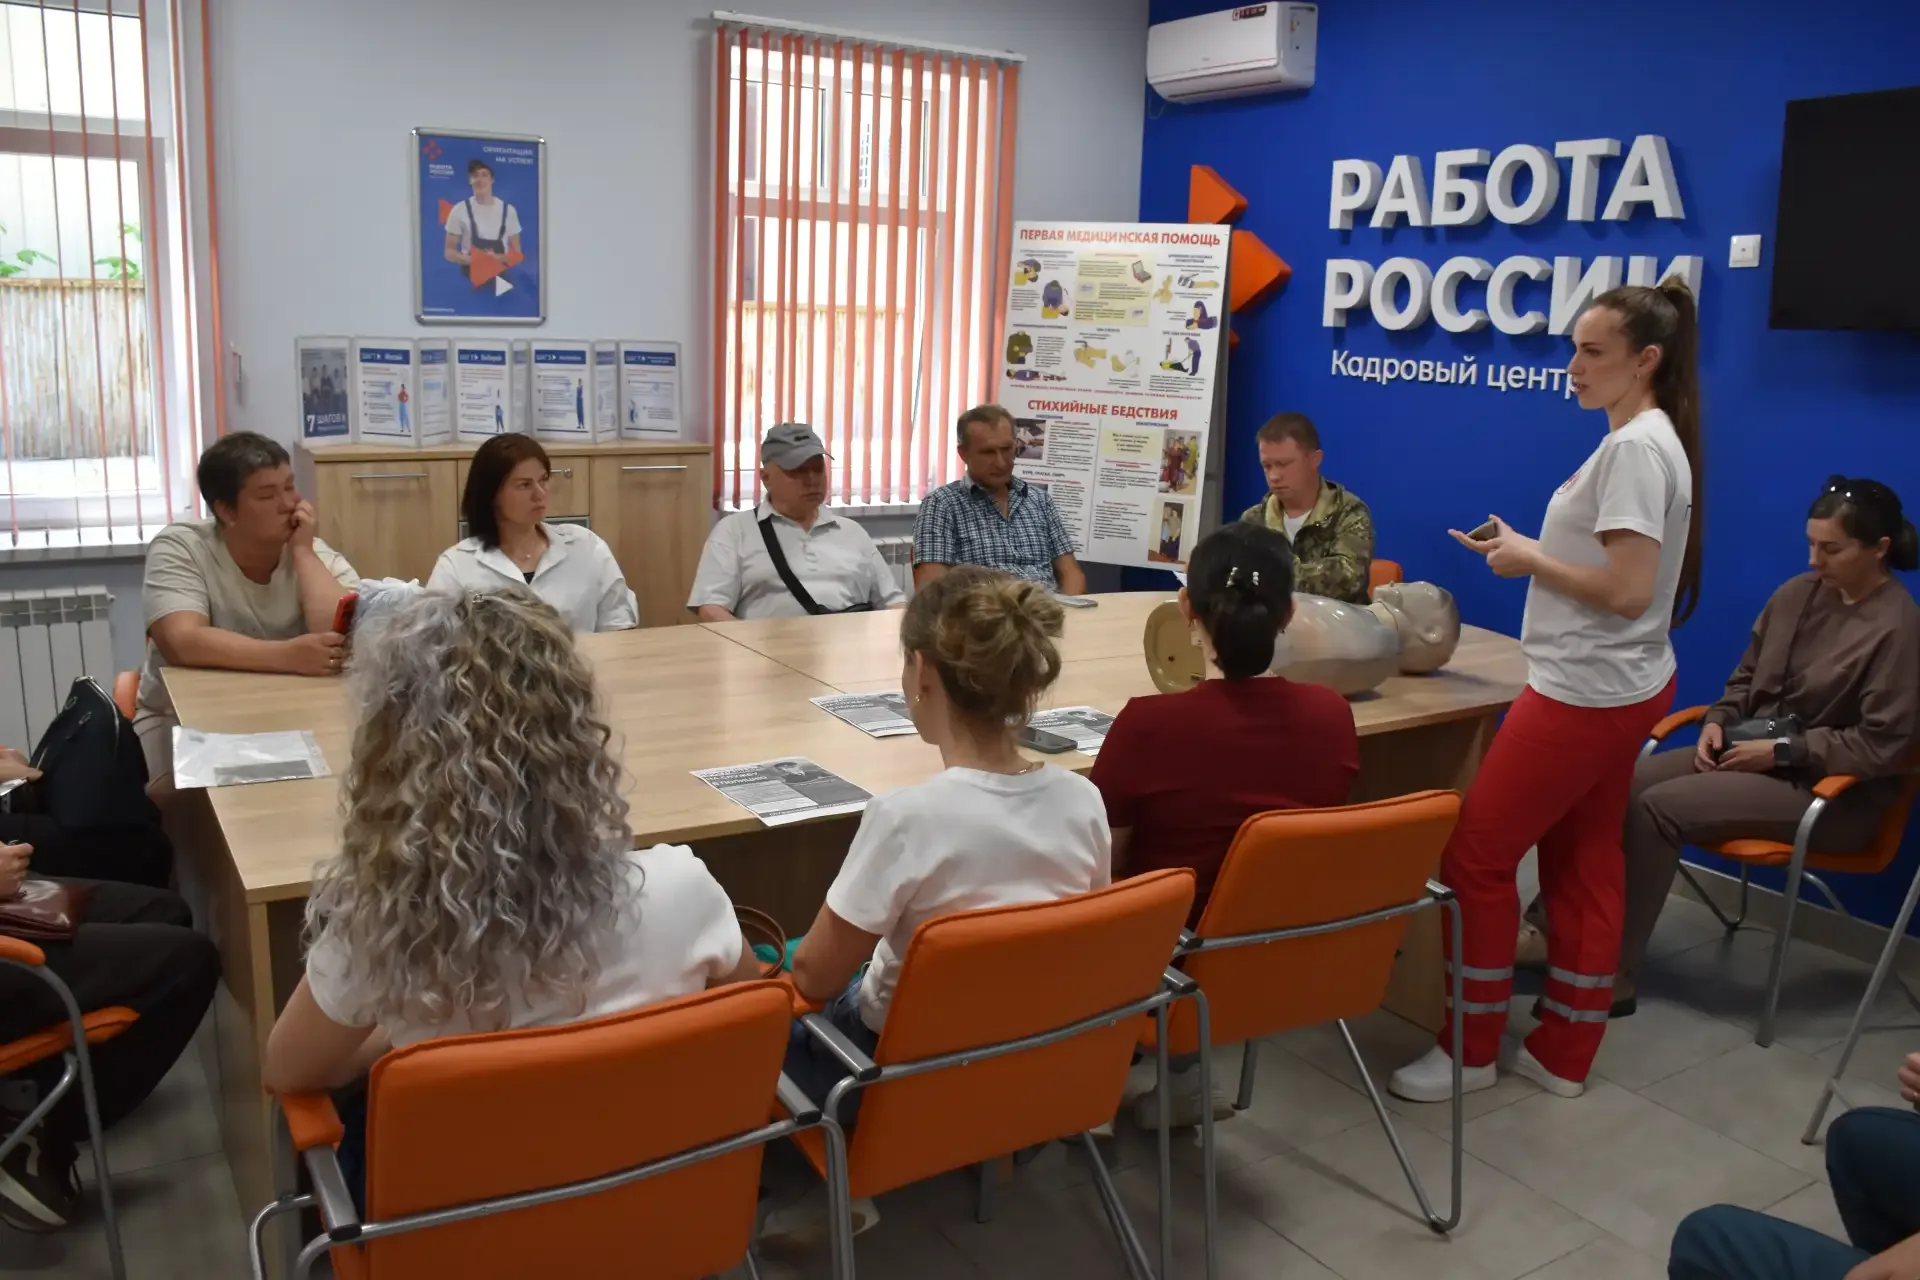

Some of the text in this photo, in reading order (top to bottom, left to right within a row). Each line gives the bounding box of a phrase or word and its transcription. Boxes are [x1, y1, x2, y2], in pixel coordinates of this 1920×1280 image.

[1329, 134, 1686, 230] РАБОТА
[1020, 229, 1221, 248] ПЕРВАЯ МЕДИЦИНСКАЯ ПОМОЩЬ
[1331, 349, 1478, 386] Кадровый
[1027, 399, 1178, 420] СТИХИЙНЫЕ БЕДСТВИЯ
[306, 413, 316, 434] 7
